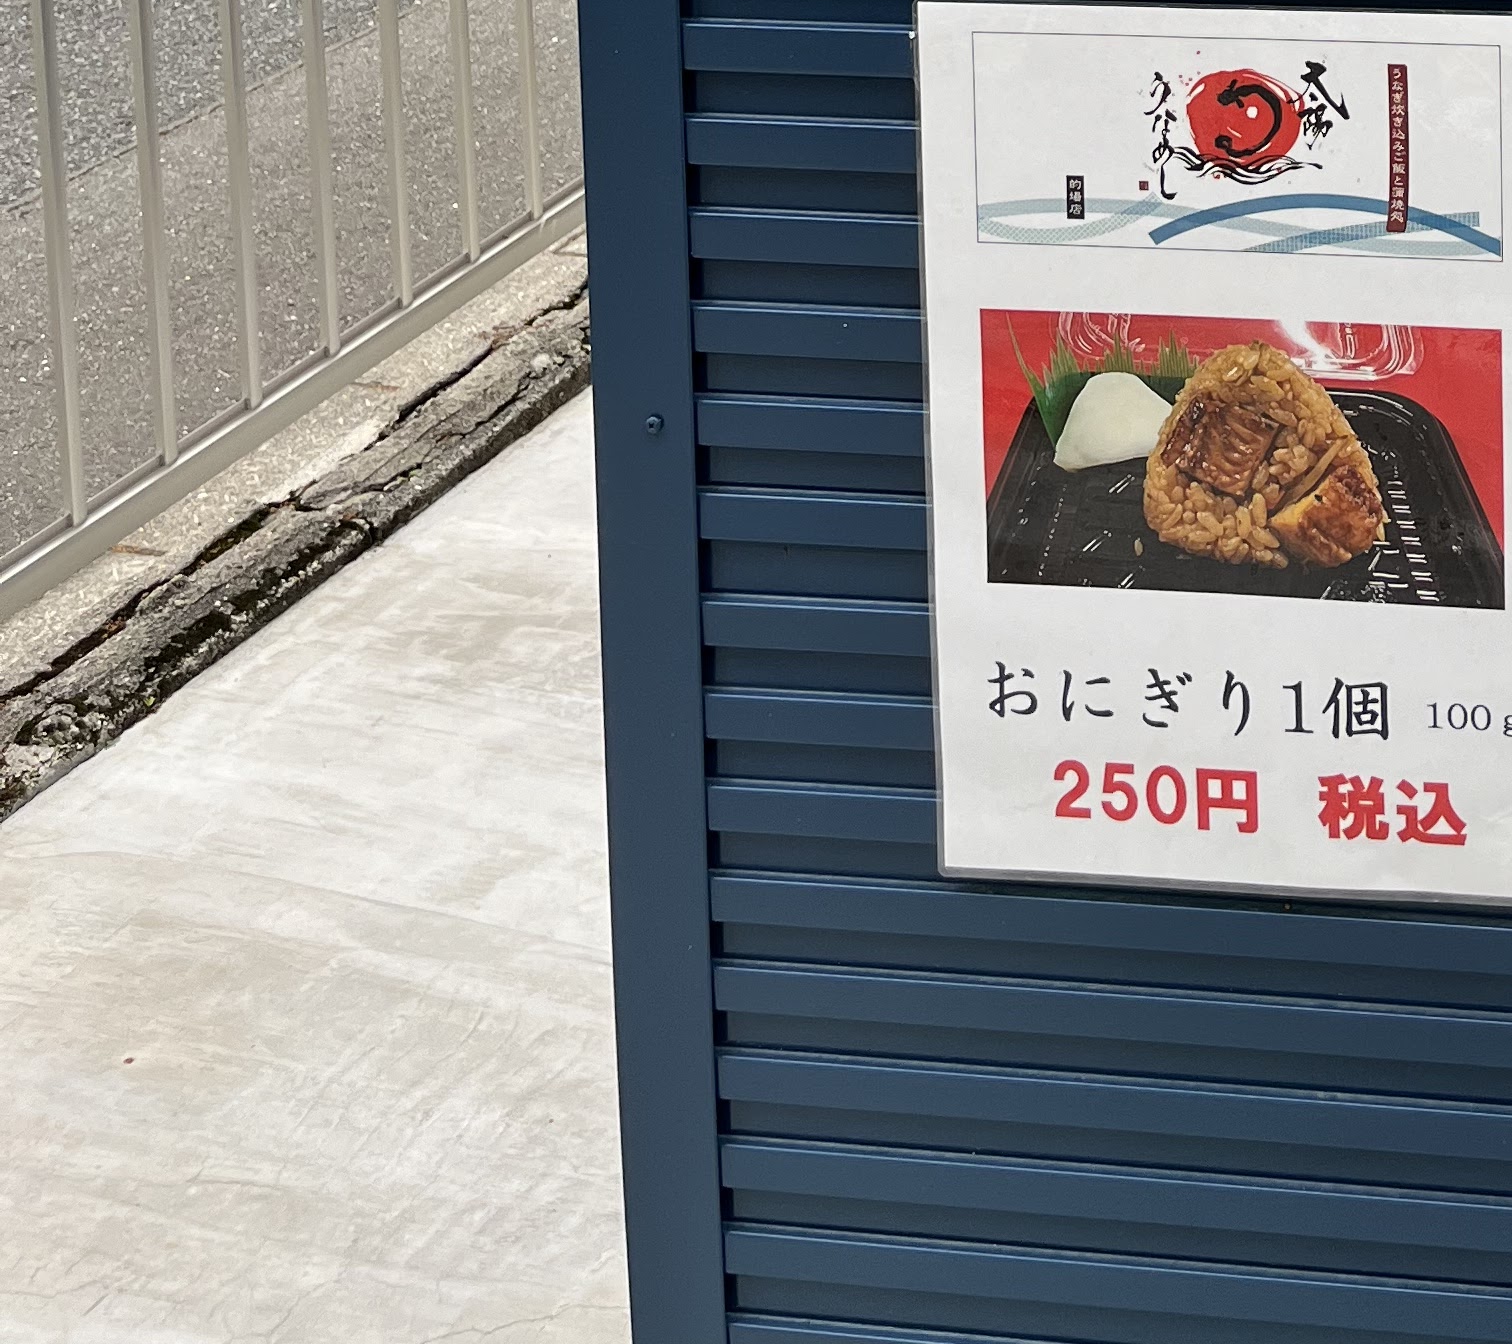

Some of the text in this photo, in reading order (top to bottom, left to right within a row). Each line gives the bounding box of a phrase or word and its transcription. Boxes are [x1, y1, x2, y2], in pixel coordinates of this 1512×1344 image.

[987, 659, 1389, 741] おにぎり1個
[1052, 759, 1467, 847] 250円 税込
